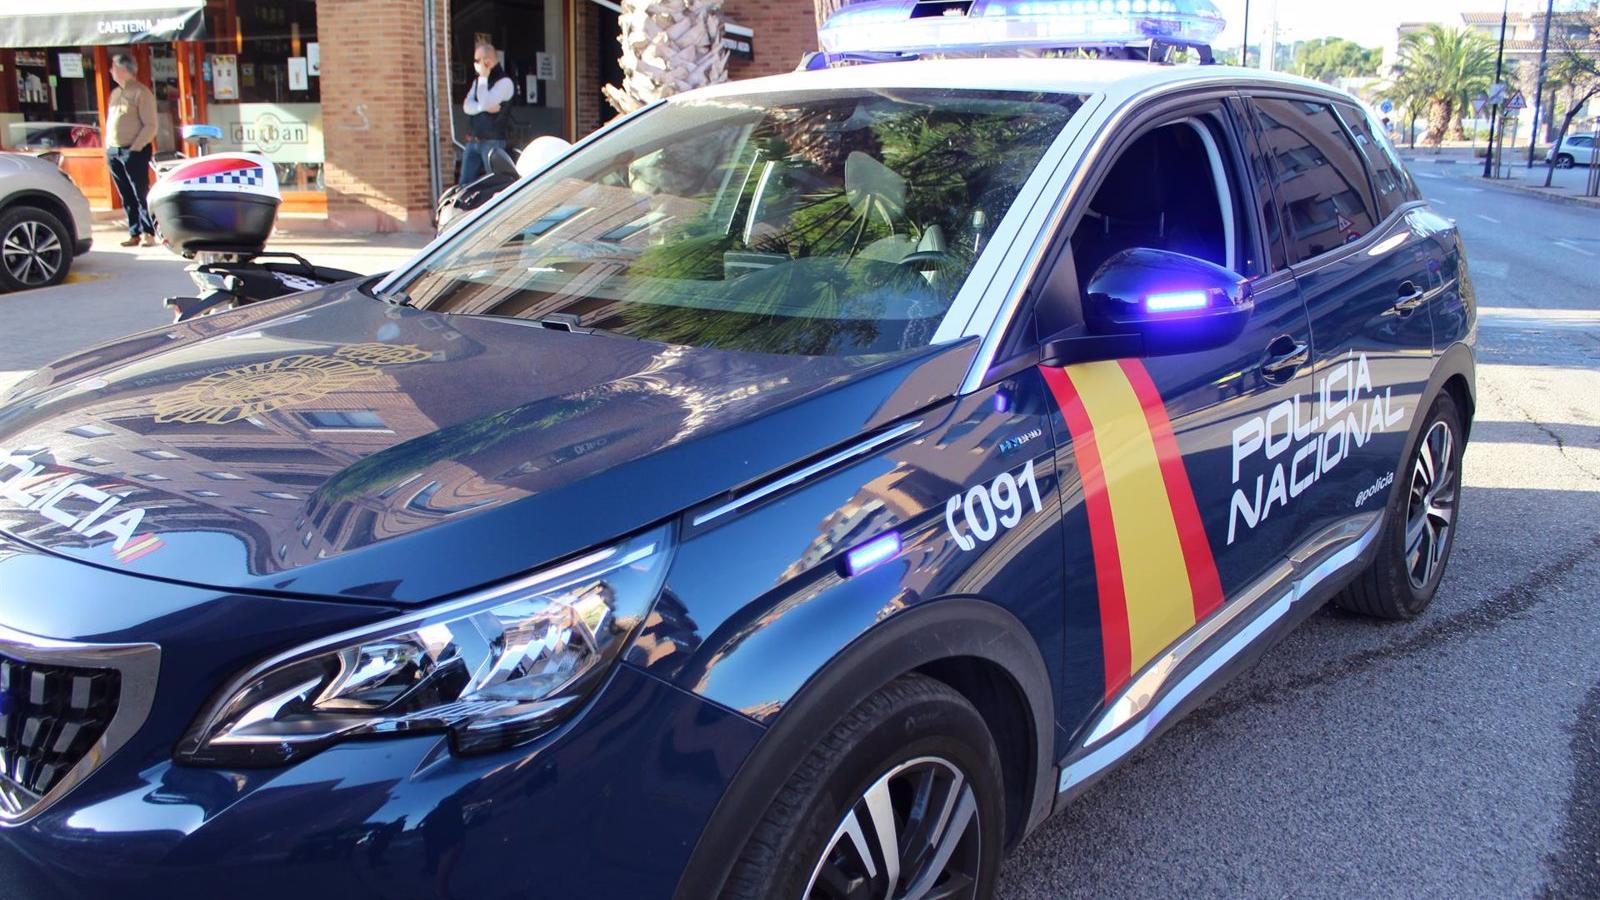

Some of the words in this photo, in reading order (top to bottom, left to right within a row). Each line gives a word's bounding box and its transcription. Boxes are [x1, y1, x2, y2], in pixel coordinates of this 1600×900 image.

[1226, 387, 1405, 546] NACIONAL
[1232, 349, 1373, 484] POLICÍA
[0, 455, 146, 551] OLICÍA
[964, 459, 1043, 542] 091
